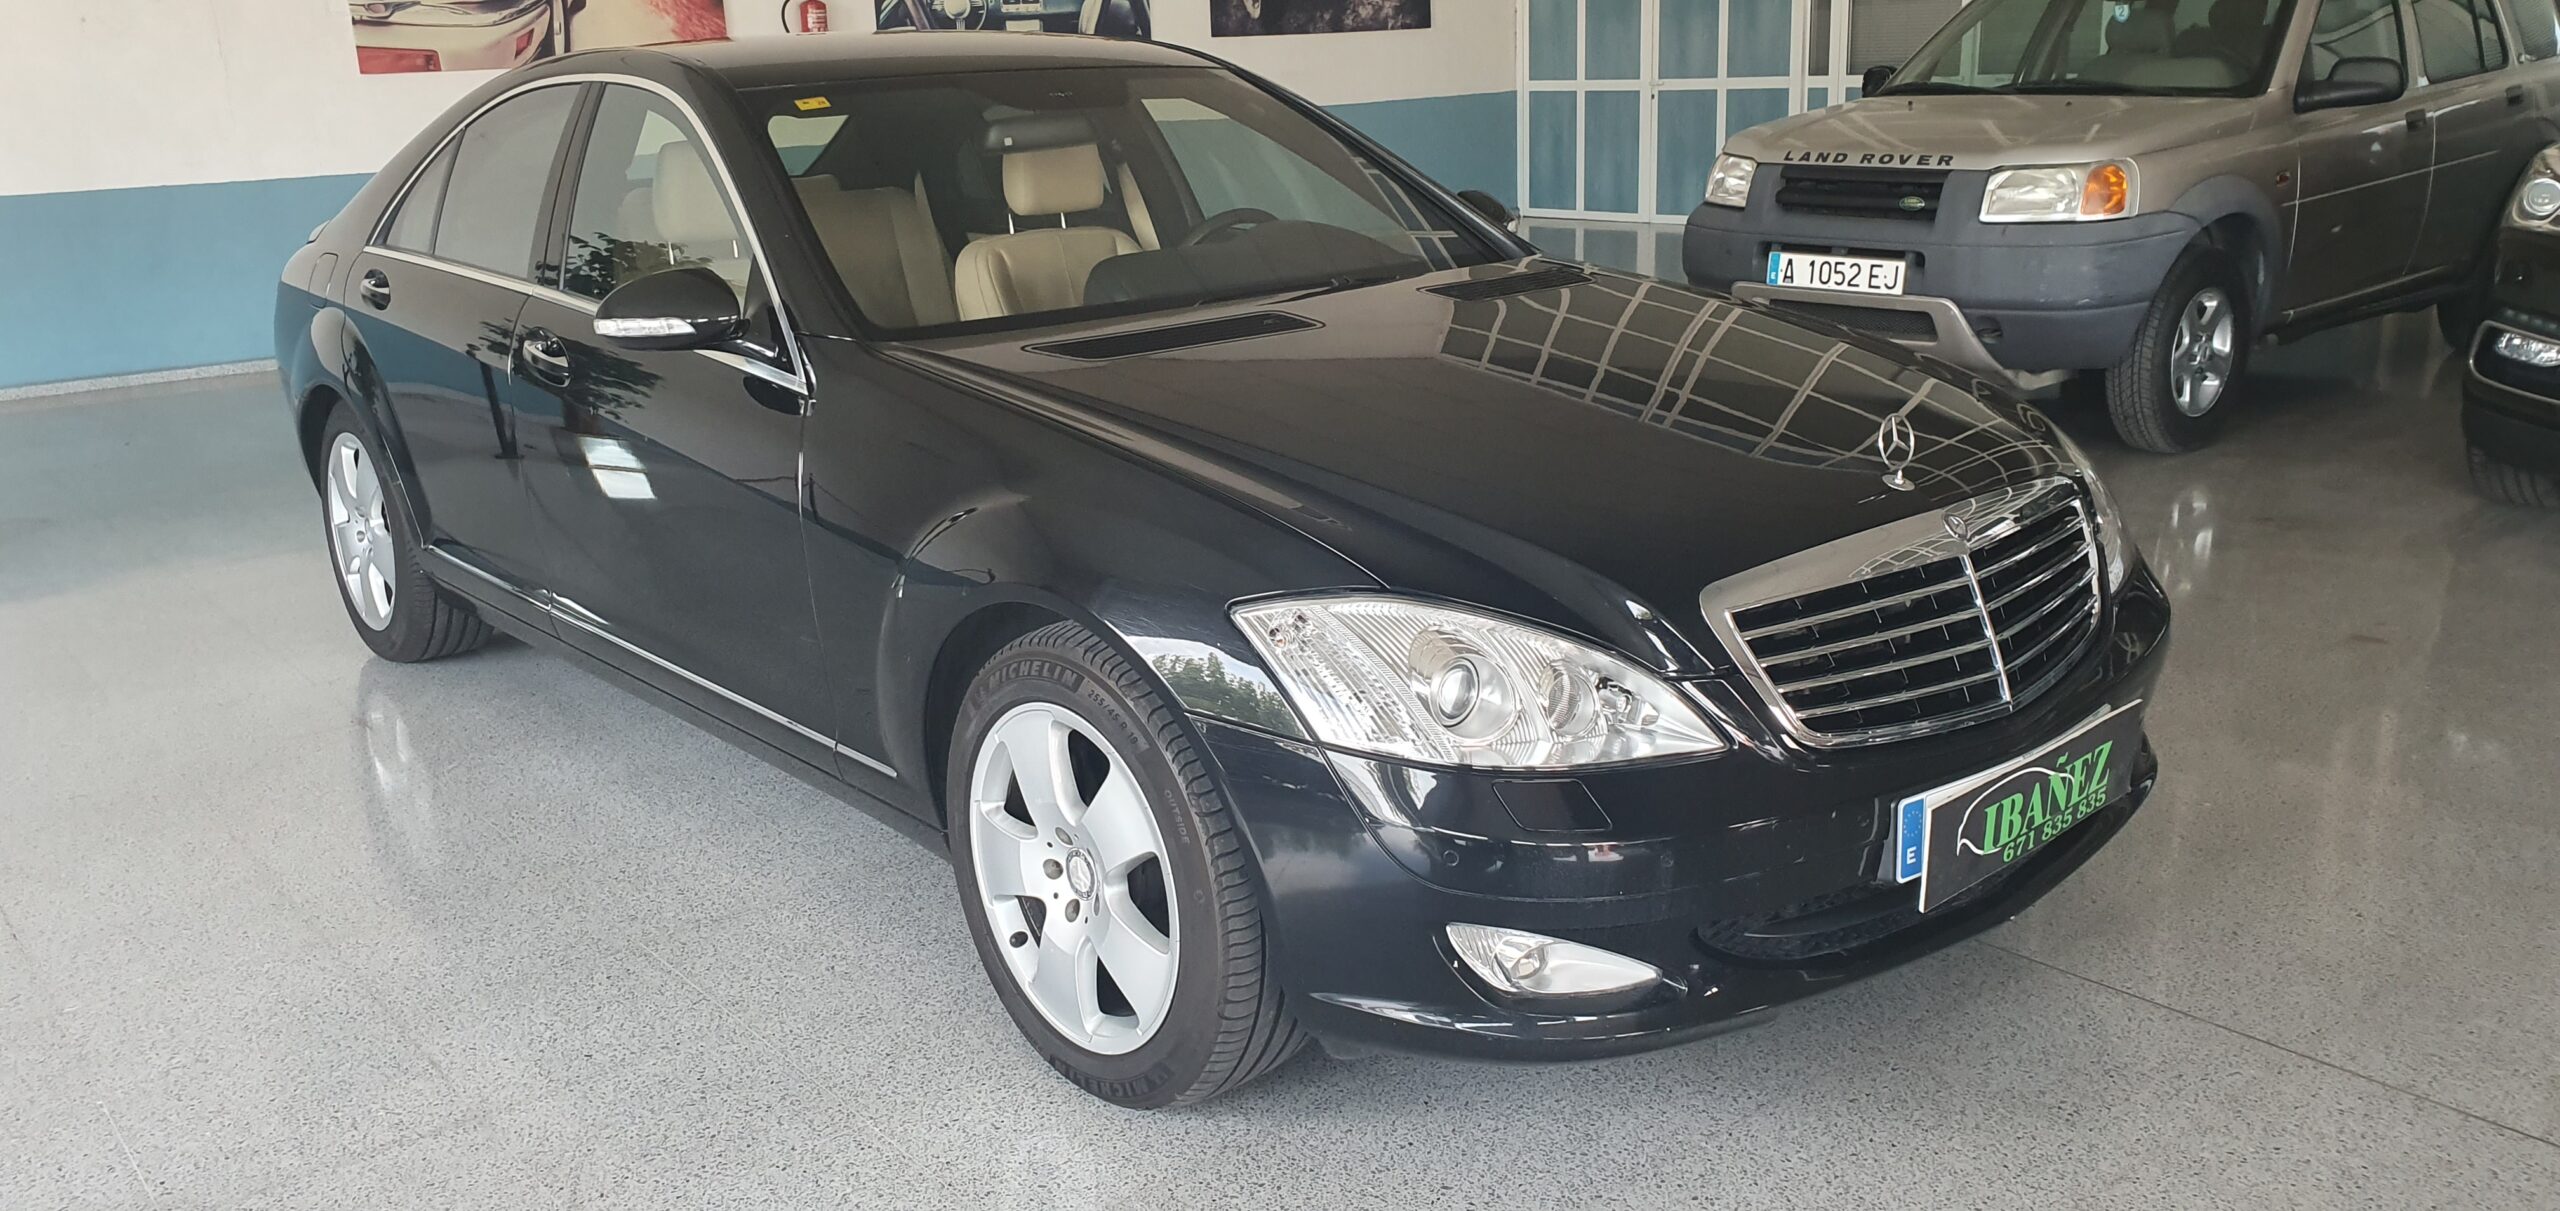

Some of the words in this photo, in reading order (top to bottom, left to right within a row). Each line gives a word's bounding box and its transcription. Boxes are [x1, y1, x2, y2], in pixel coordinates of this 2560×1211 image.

[1784, 151, 1848, 163] LAND
[1860, 153, 1954, 166] ROVER
[1782, 258, 1794, 283] A
[1809, 260, 1861, 287] 1052
[989, 661, 1077, 690] MICHELIN
[1984, 740, 2113, 854] IBAÑEZ
[1164, 789, 1191, 845] OUTSIDE
[2003, 830, 2034, 862] 671
[2042, 807, 2073, 840] 835
[2077, 786, 2107, 819] 835
[1907, 847, 1916, 864] E
